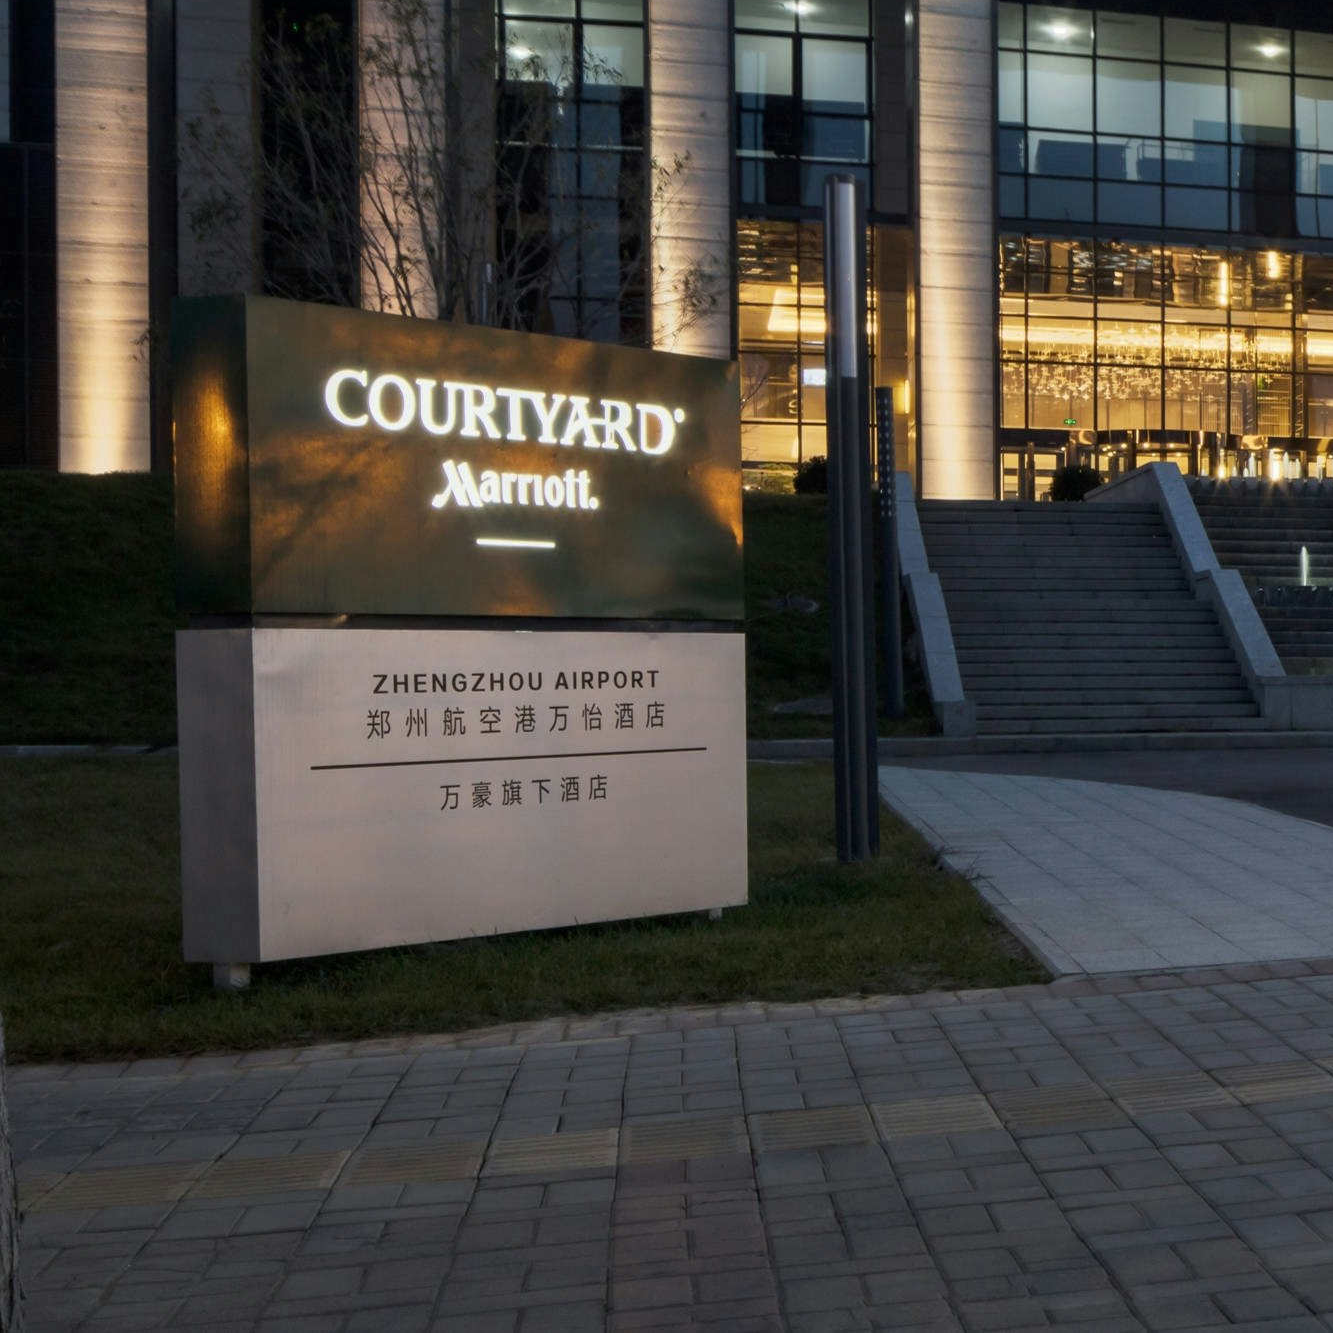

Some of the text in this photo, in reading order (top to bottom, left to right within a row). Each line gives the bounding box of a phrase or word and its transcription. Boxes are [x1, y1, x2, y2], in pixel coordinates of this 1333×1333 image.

[324, 368, 677, 456] COURTYARD
[372, 669, 660, 695] ZHENGZHOU AIRPORT
[366, 700, 666, 740] 郑州航空港万怡酒店
[439, 773, 609, 812] 万豪旗下酒店
